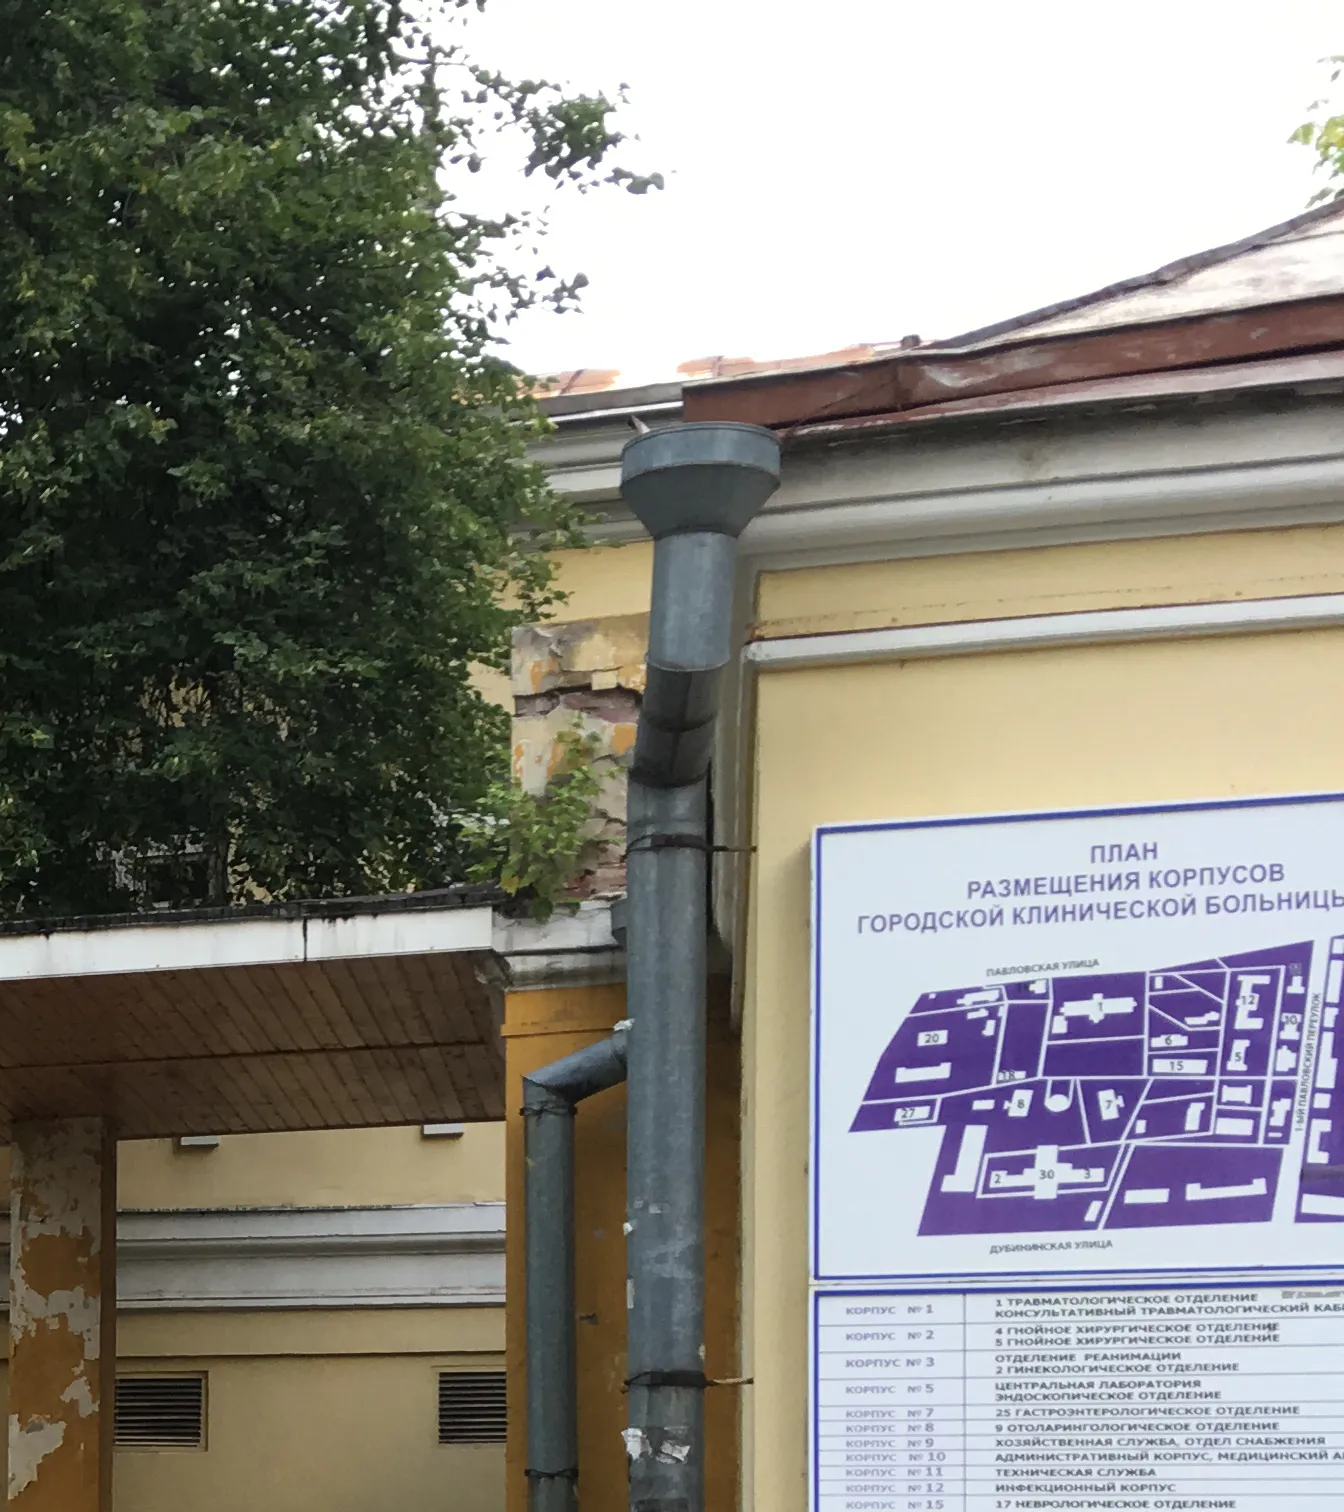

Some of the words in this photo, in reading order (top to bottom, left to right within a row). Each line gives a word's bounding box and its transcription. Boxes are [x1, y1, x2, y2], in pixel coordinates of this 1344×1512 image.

[1090, 842, 1158, 863] ПЛАН
[967, 871, 1140, 899] РАЗМЕЩЕНИЯ
[1149, 863, 1285, 889] КОРПУСОВ
[857, 904, 1004, 934] ГОРОДСКОЙ
[1012, 894, 1197, 925] КЛИНИЧЕСКОЙ
[986, 962, 1059, 977] ПАВЛОВСКАЯ
[1062, 958, 1100, 970] УЛИЦА
[1241, 994, 1255, 1005] 12
[1307, 993, 1320, 1041] ПЕРЕУЛОК
[924, 1033, 940, 1044] 20
[1165, 1036, 1172, 1045] 6
[1170, 1061, 1184, 1071] 15
[1017, 1099, 1025, 1109] 8
[1105, 1100, 1113, 1110] 7
[901, 1108, 915, 1119] 27
[994, 1174, 1002, 1184] 2
[1039, 1170, 1055, 1180] 30
[1074, 1239, 1113, 1250] УЛИЦА
[996, 1298, 1003, 1307] 1
[1006, 1295, 1170, 1306] ТРАВМАТОЛОГИЧЕСКОЕ
[1174, 1293, 1258, 1305] ОТДЕЛЕНИЕ
[845, 1305, 896, 1315] КОРПУС
[907, 1305, 923, 1314] №
[925, 1304, 934, 1313] 1
[995, 1305, 1136, 1318] КОНСУЛЬТАТИВНЫЙ
[1140, 1302, 1309, 1315] ТРАВМАТОЛОГИЧЕСКИЙ
[995, 1326, 1003, 1335] 4
[1006, 1323, 1071, 1335] ГНОЙНОЕ
[1075, 1323, 1191, 1334] ХИРУРГИЧЕСКОЕ
[1195, 1322, 1279, 1333] ОТДЕЛЕНИЕ
[845, 1330, 895, 1341] КОРПУС
[907, 1330, 922, 1340] №
[925, 1330, 934, 1340] 2
[995, 1338, 1002, 1346] 5
[1006, 1335, 1072, 1346] ГНОЙНОЕ
[1075, 1335, 1191, 1345] ХИРУРГИЧЕСКОЕ
[1195, 1333, 1280, 1344] ОТДЕЛЕНИЕ
[845, 1357, 900, 1368] КОРПУС
[905, 1357, 922, 1367] №
[925, 1357, 935, 1367] 3
[994, 1353, 1076, 1364] ОТДЕЛЕНИЕ
[1084, 1352, 1181, 1363] РЕАНИМАЦИИ
[995, 1366, 1003, 1374] 2
[1006, 1364, 1151, 1374] ГИНЕКОЛОГИЧЕСКОЕ
[1155, 1363, 1239, 1373] ОТДЕЛЕНИЕ
[845, 1383, 896, 1394] КОРПУС
[906, 1383, 922, 1393] №
[924, 1383, 934, 1393] 5
[995, 1381, 1095, 1391] ЦЕНТРАЛЬНАЯ
[1098, 1379, 1201, 1389] ЛАБОРАТОРИЯ
[995, 1391, 1134, 1403] ЭНДОСКОПИЧЕСКОЕ
[1138, 1391, 1221, 1401] ОТДЕЛЕНИЕ
[845, 1408, 895, 1418] КОРПУС
[906, 1408, 922, 1417] №
[925, 1408, 934, 1417] 7
[995, 1408, 1011, 1417] 25
[1015, 1407, 1211, 1417] ГАСТРОЭНТЕРОЛОГИЧЕСКОЕ
[1215, 1406, 1299, 1416] ОТДЕЛЕНИЕ
[845, 1423, 895, 1433] КОРПУС
[907, 1423, 922, 1432] №
[924, 1423, 935, 1432] 8
[995, 1424, 1003, 1432] 9
[1006, 1422, 1191, 1432] ОТОЛАРИНГОЛОГИЧЕСКОЕ
[1195, 1422, 1279, 1432] ОТДЕЛЕНИЕ
[845, 1439, 896, 1448] КОРПУС
[907, 1438, 922, 1447] №
[924, 1438, 934, 1447] 9
[995, 1436, 1113, 1447] ХОЗЯЙСТВЕННАЯ
[1184, 1437, 1231, 1447] ОТДЕЛ
[1235, 1436, 1325, 1445] СНАБЖЕНИЯ
[845, 1452, 896, 1462] КОРПУС
[908, 1452, 923, 1462] №
[927, 1452, 946, 1462] 10
[995, 1450, 1149, 1462] АДМИНИСТРАТИВНЫЙ
[1153, 1452, 1213, 1462] КОРПУС,
[1217, 1449, 1328, 1462] МЕДИЦИНСКИЙ
[845, 1467, 896, 1477] КОРПУС
[907, 1467, 922, 1477] №
[925, 1467, 943, 1477] 11
[995, 1468, 1093, 1476] ТЕХНИЧЕСКАЯ
[1096, 1468, 1157, 1476] СЛУЖБА
[845, 1483, 895, 1492] КОРПУС
[907, 1483, 922, 1492] №
[925, 1483, 944, 1492] 12
[995, 1481, 1116, 1493] ИНФЕКЦИОННЫЙ
[1120, 1483, 1176, 1492] КОРПУС
[996, 1500, 1011, 1508] 17
[1015, 1500, 1150, 1508] НЕВРОЛОГИЧЕСКОЕ
[1153, 1500, 1236, 1510] ОТДЕЛЕНИЕ
